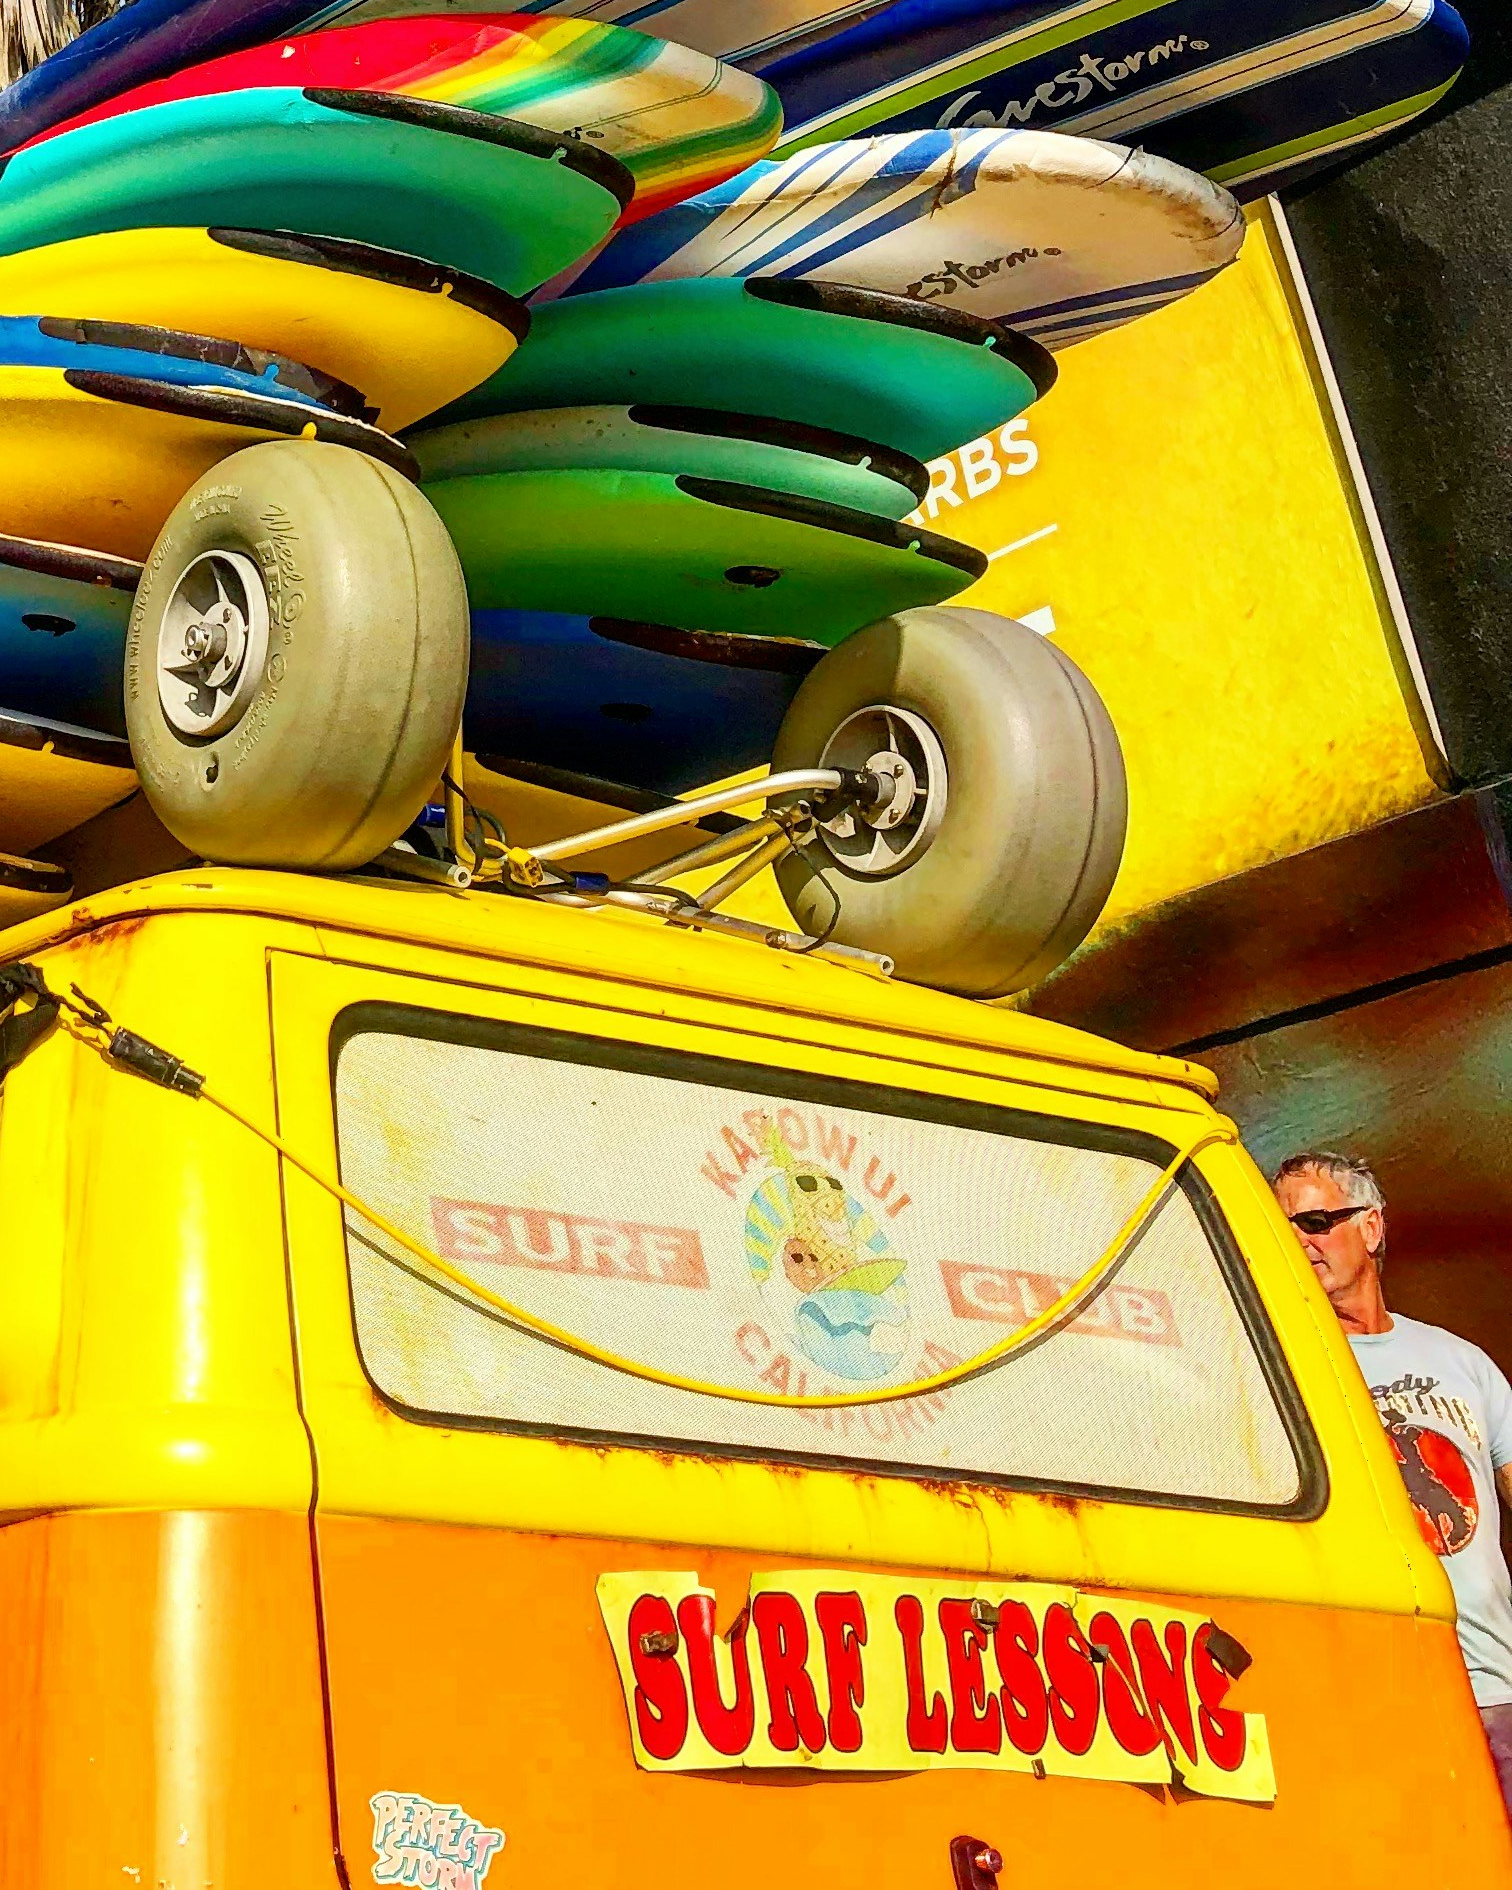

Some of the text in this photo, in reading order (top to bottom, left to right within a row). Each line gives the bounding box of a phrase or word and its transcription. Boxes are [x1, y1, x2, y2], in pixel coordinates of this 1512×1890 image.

[906, 246, 1039, 299] estorm
[908, 418, 1039, 526] RBS
[448, 1209, 682, 1279] SURF
[1370, 1373, 1441, 1399] ody
[626, 1590, 1249, 1773] SURF LESSONS
[371, 1794, 503, 1874] PERFECT
[374, 1829, 479, 1890] STORM
